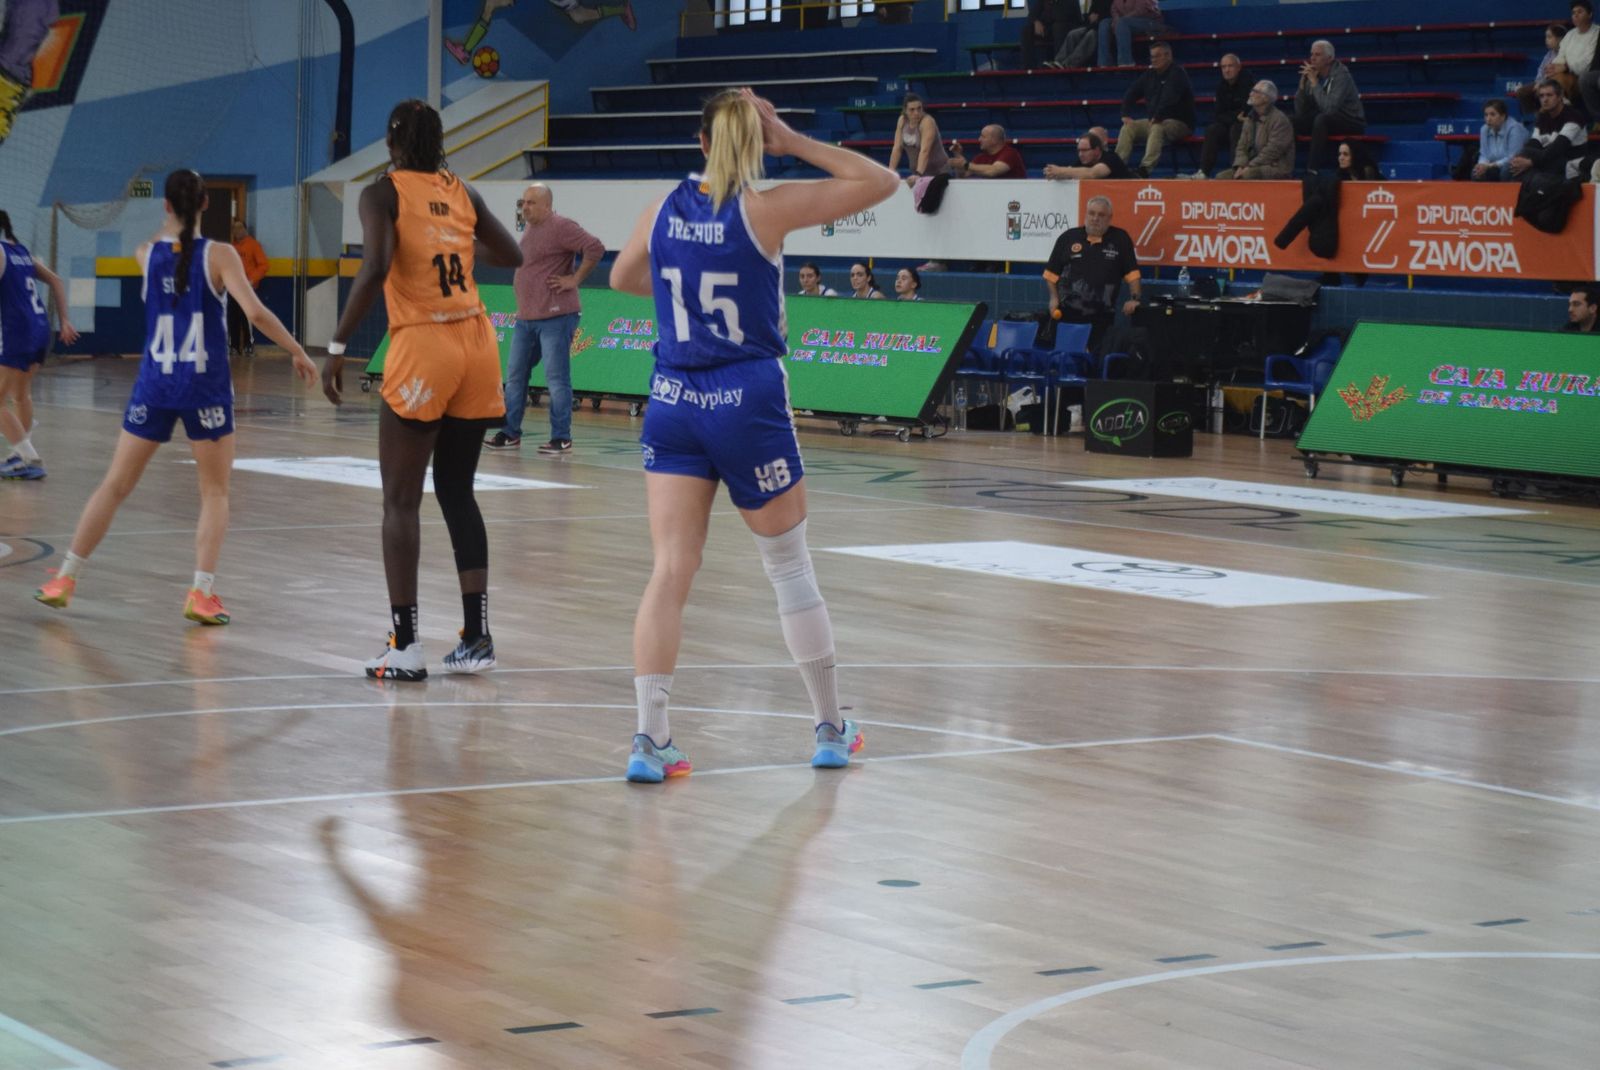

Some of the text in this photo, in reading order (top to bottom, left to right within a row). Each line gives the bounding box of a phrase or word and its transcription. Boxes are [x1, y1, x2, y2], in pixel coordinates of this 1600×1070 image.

[1022, 211, 1071, 230] ZAMORA
[1173, 234, 1272, 265] ZAMORA
[1408, 240, 1522, 274] ZAMORA
[432, 253, 468, 298] 14
[660, 267, 745, 346] 15
[150, 312, 209, 374] 44
[860, 332, 942, 353] RURAL
[683, 387, 744, 410] myplay
